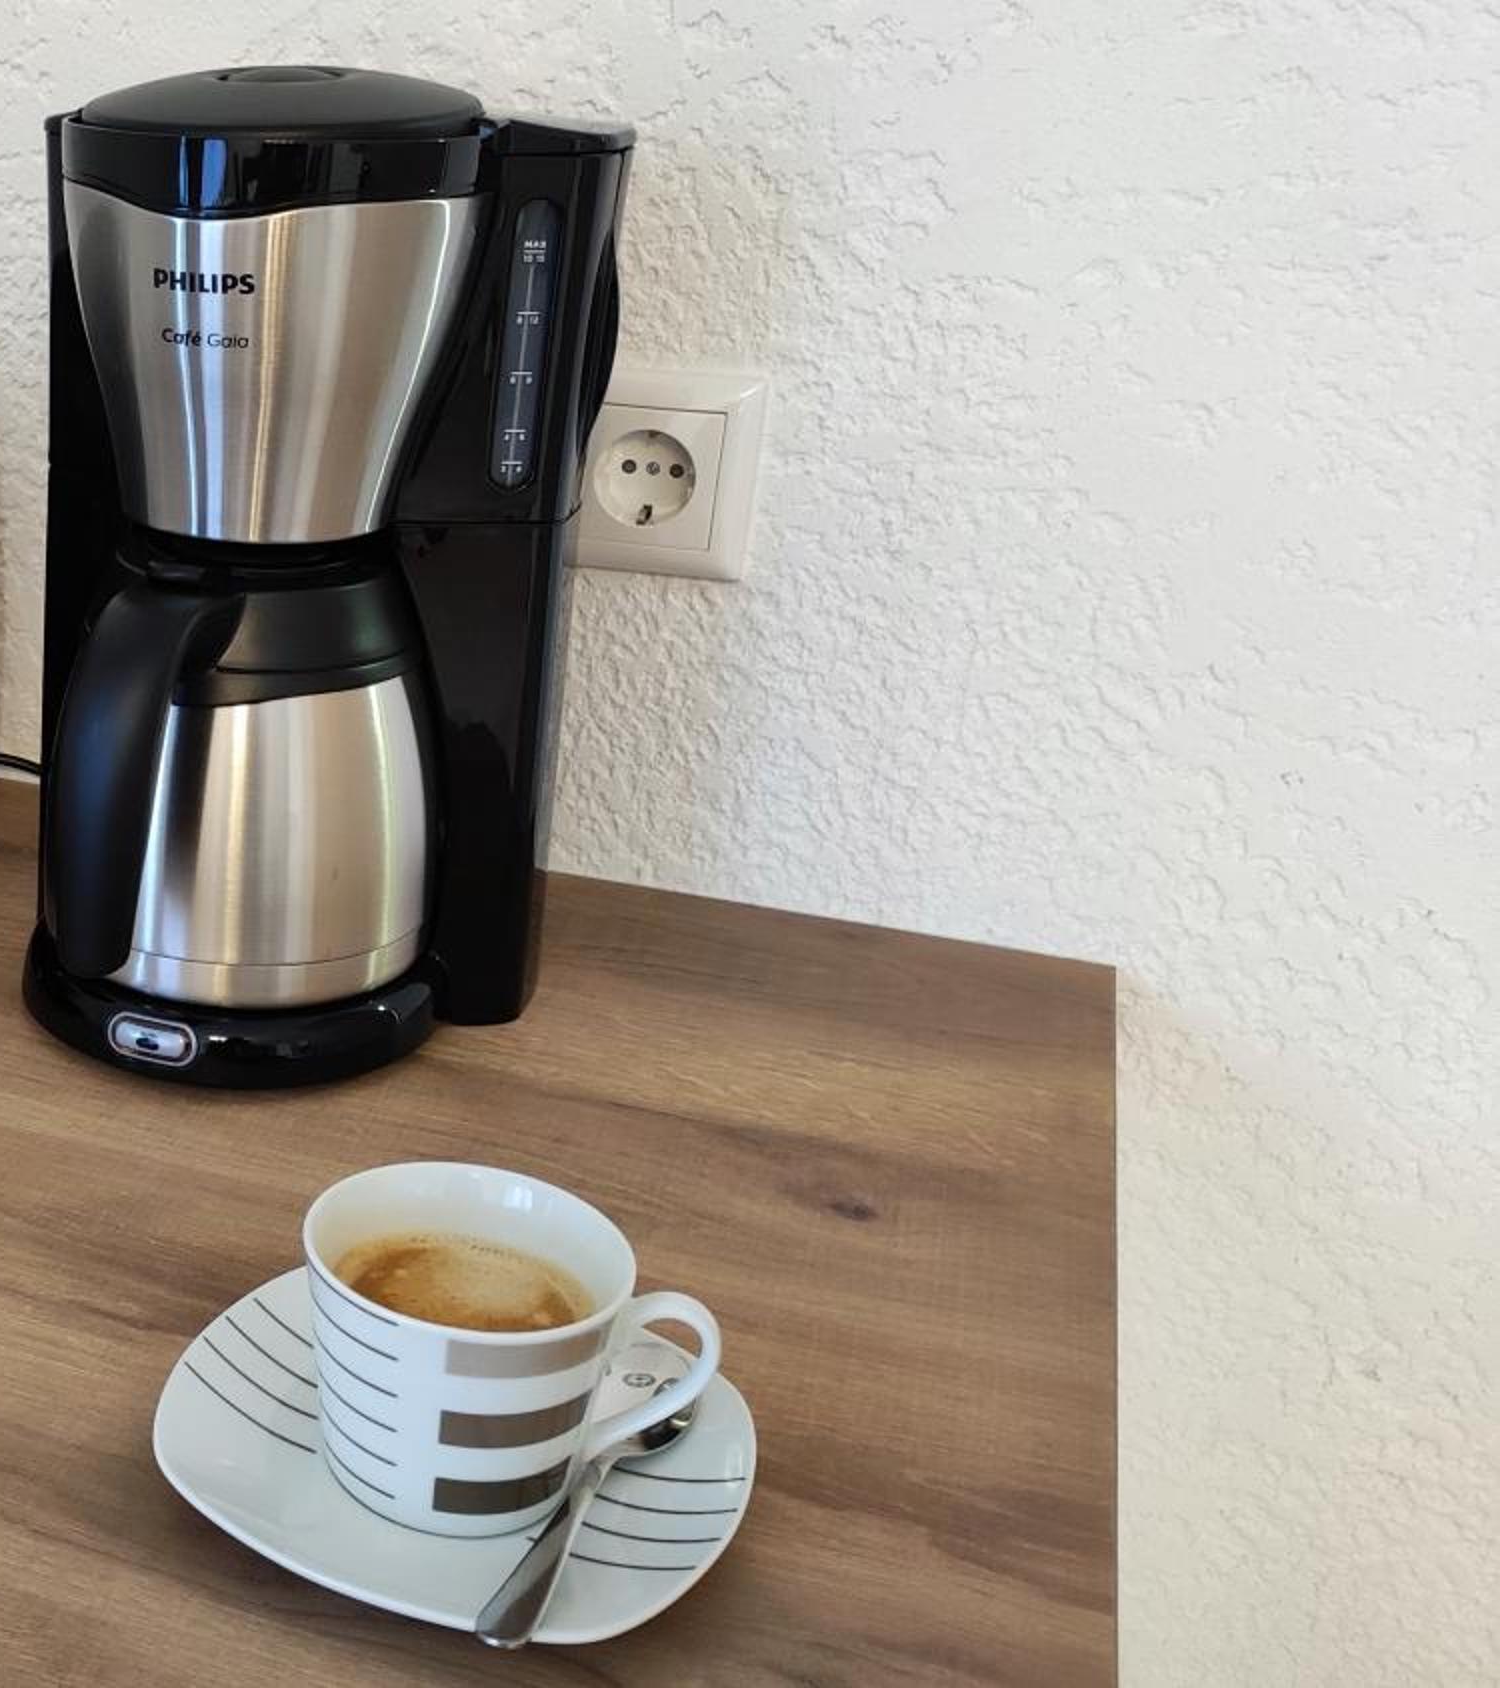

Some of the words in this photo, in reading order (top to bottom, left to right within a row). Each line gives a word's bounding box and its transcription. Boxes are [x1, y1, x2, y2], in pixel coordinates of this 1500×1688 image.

[153, 267, 255, 295] PHILIPS
[161, 328, 201, 347] Café
[207, 333, 249, 349] Gaia
